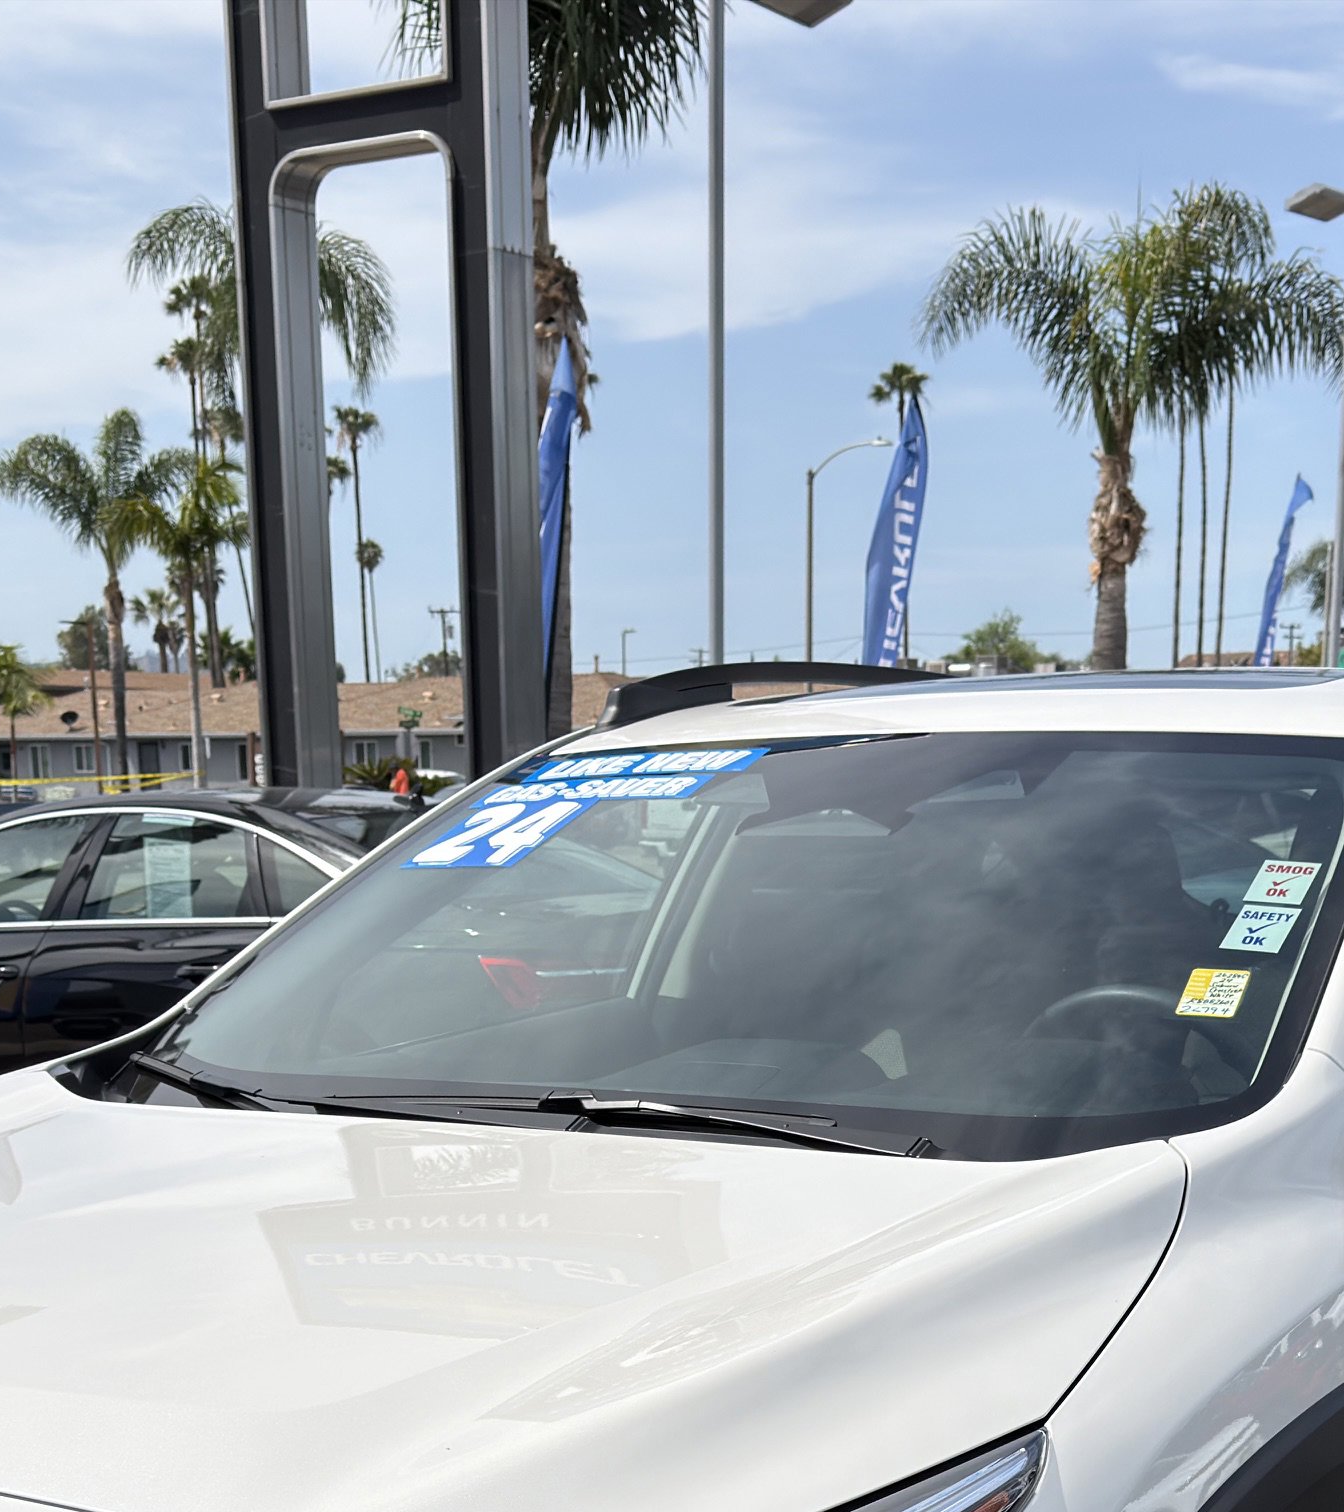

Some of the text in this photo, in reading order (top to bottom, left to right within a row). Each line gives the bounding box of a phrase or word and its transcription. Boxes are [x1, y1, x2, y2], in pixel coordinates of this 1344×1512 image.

[538, 749, 754, 780] LIKE NEW
[412, 801, 584, 866] 24
[1264, 864, 1315, 876] SMOG
[1266, 888, 1290, 898] OK
[1241, 910, 1295, 923] SAFETY
[1241, 935, 1267, 946] OK
